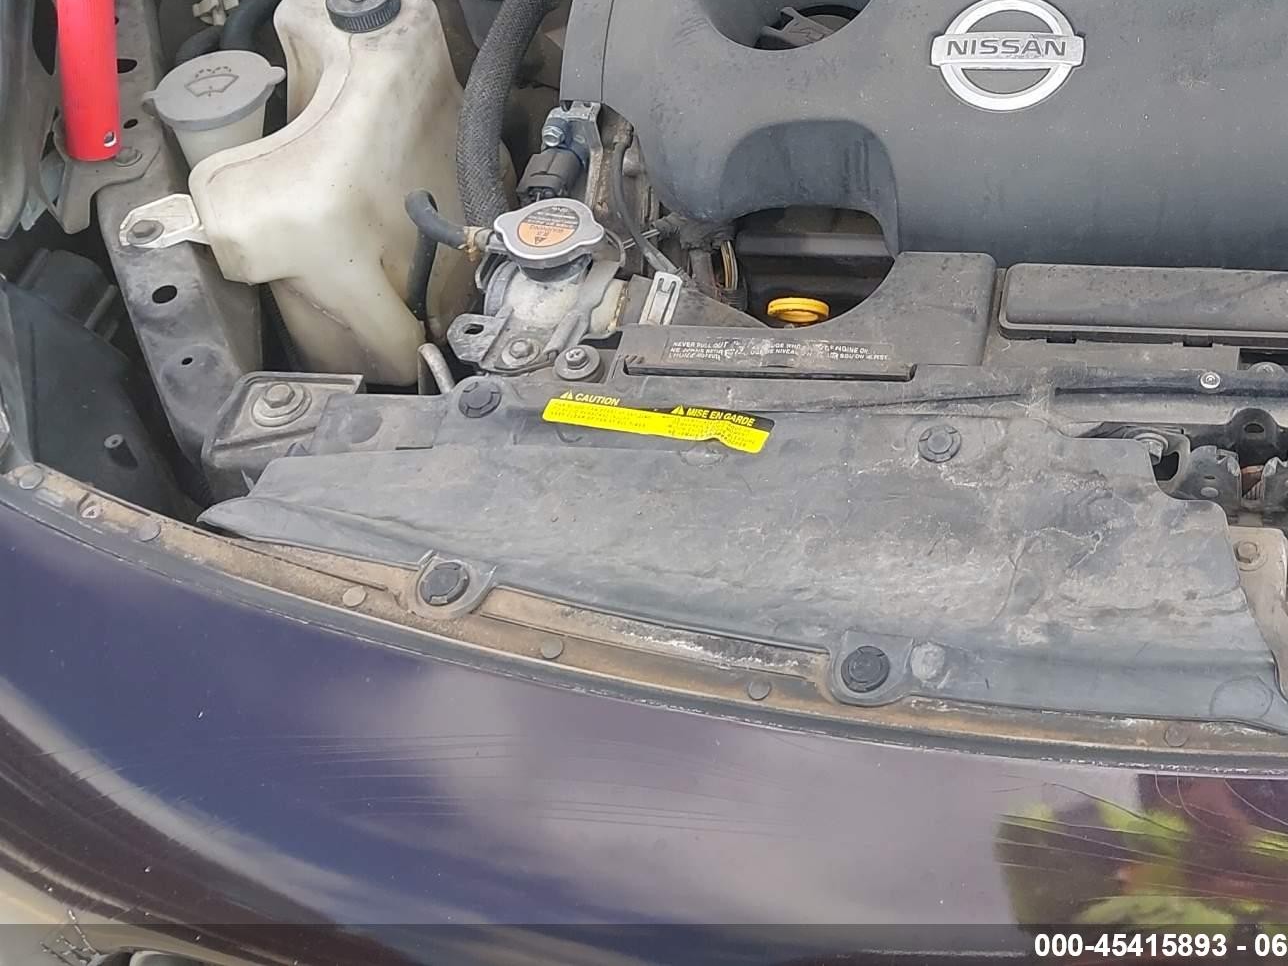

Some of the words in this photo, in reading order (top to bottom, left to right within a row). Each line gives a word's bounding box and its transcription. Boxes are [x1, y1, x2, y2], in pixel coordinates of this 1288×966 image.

[946, 38, 1067, 57] NISSAN
[575, 393, 621, 406] CAUTION
[686, 407, 708, 419] MISE
[709, 410, 723, 420] EN
[724, 413, 756, 427] GARDE
